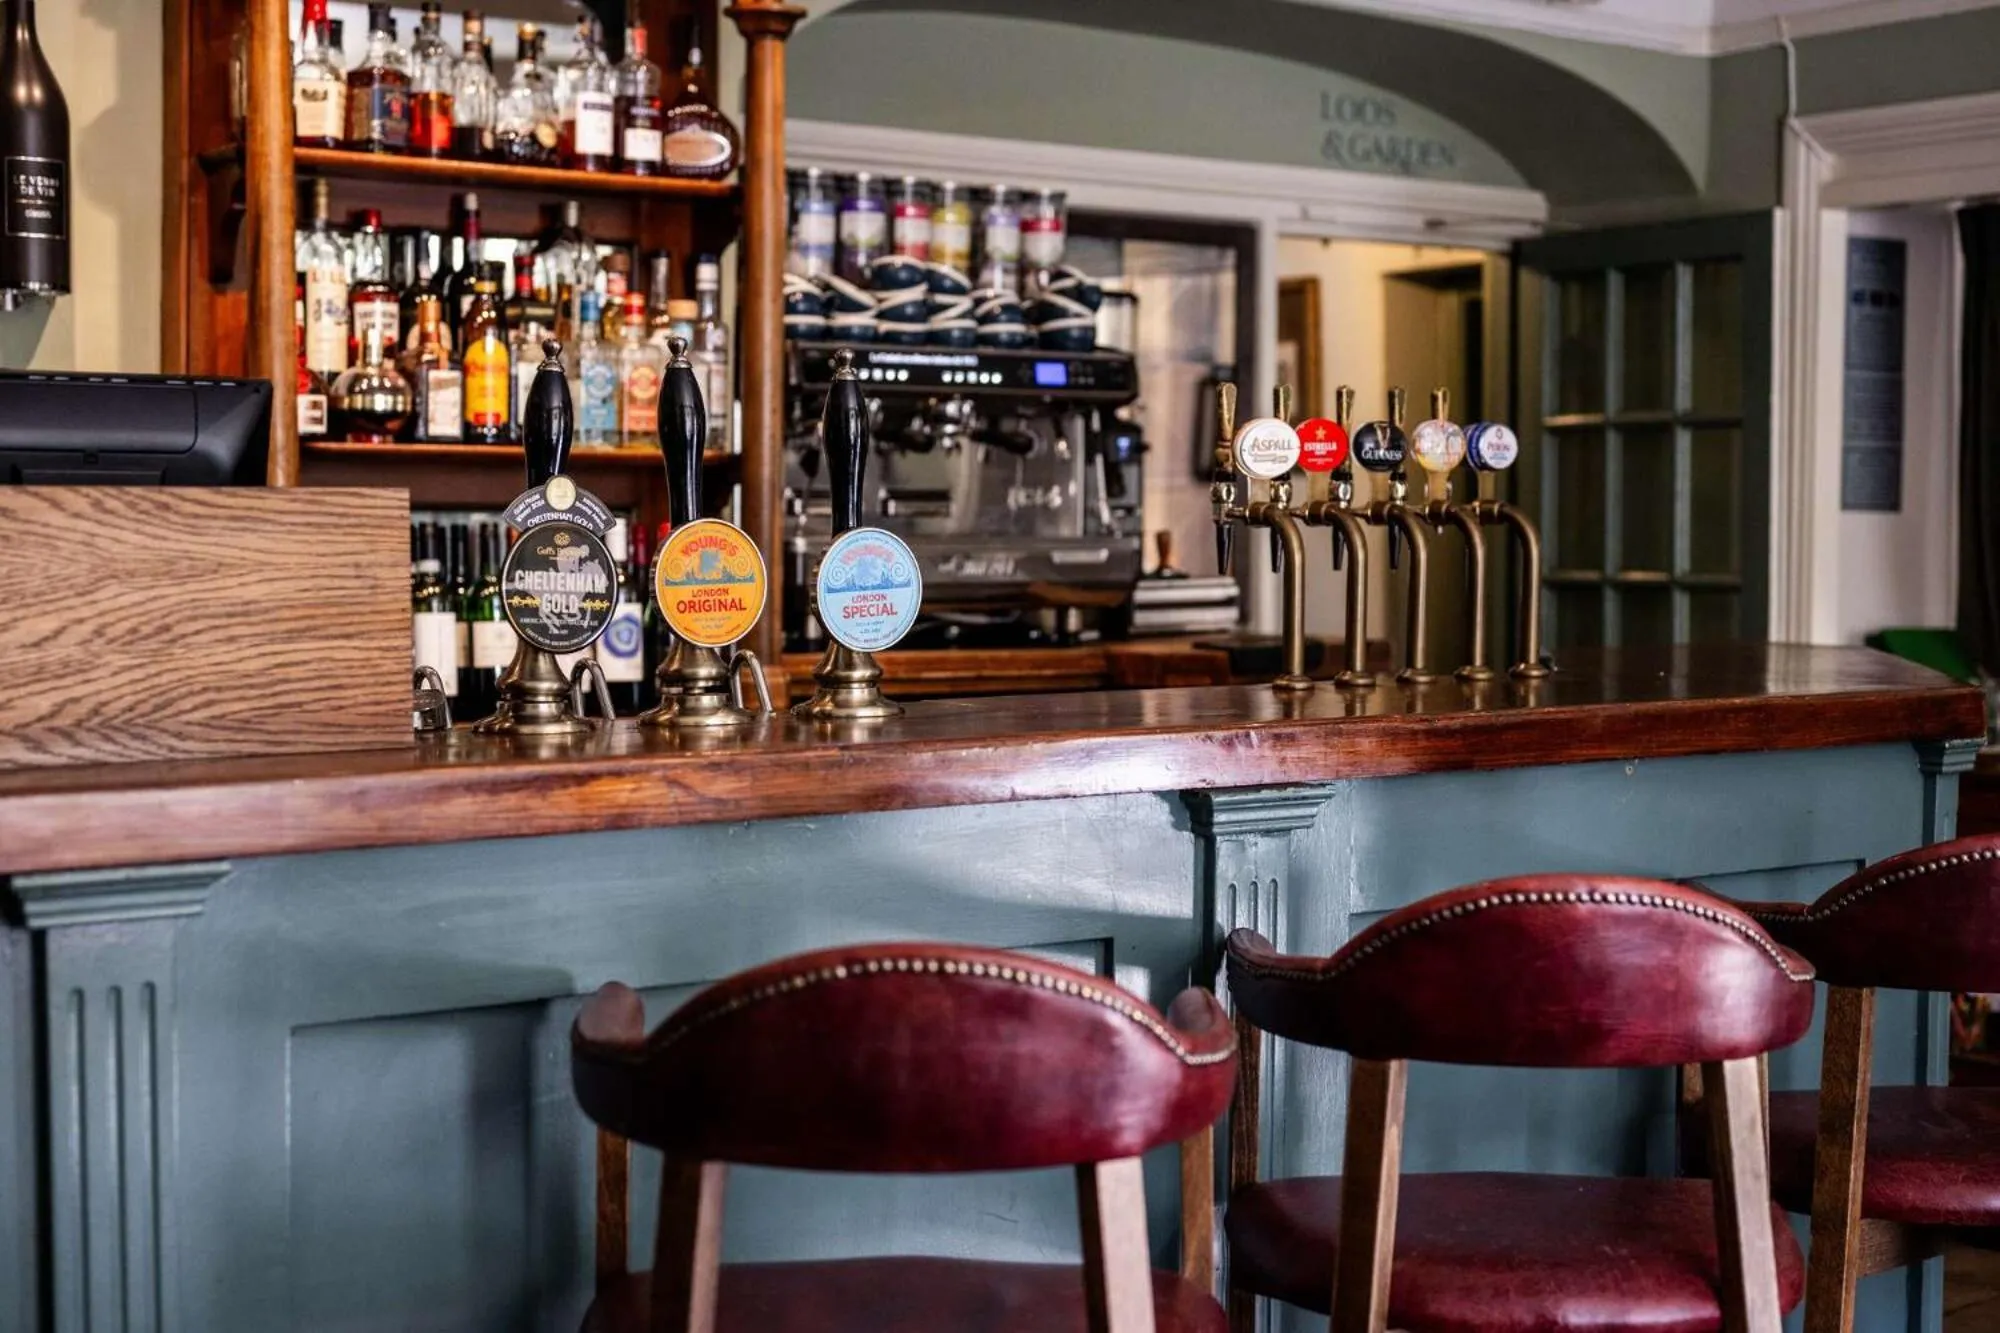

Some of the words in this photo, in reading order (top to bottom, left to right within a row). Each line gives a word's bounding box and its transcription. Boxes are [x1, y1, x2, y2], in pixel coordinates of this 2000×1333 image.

[1251, 436, 1295, 452] ASPALL
[1361, 449, 1402, 460] GUINNESS
[527, 512, 573, 527] CHELTENHAM
[574, 515, 593, 530] GOLD
[681, 535, 740, 557] YOUNG'S
[515, 569, 607, 593] CHELTENHAM
[692, 587, 730, 598] LONDON
[852, 593, 888, 604] LONDON
[542, 593, 579, 614] GOLD
[676, 598, 748, 614] ORIGINAL
[842, 603, 898, 620] SPECIAL
